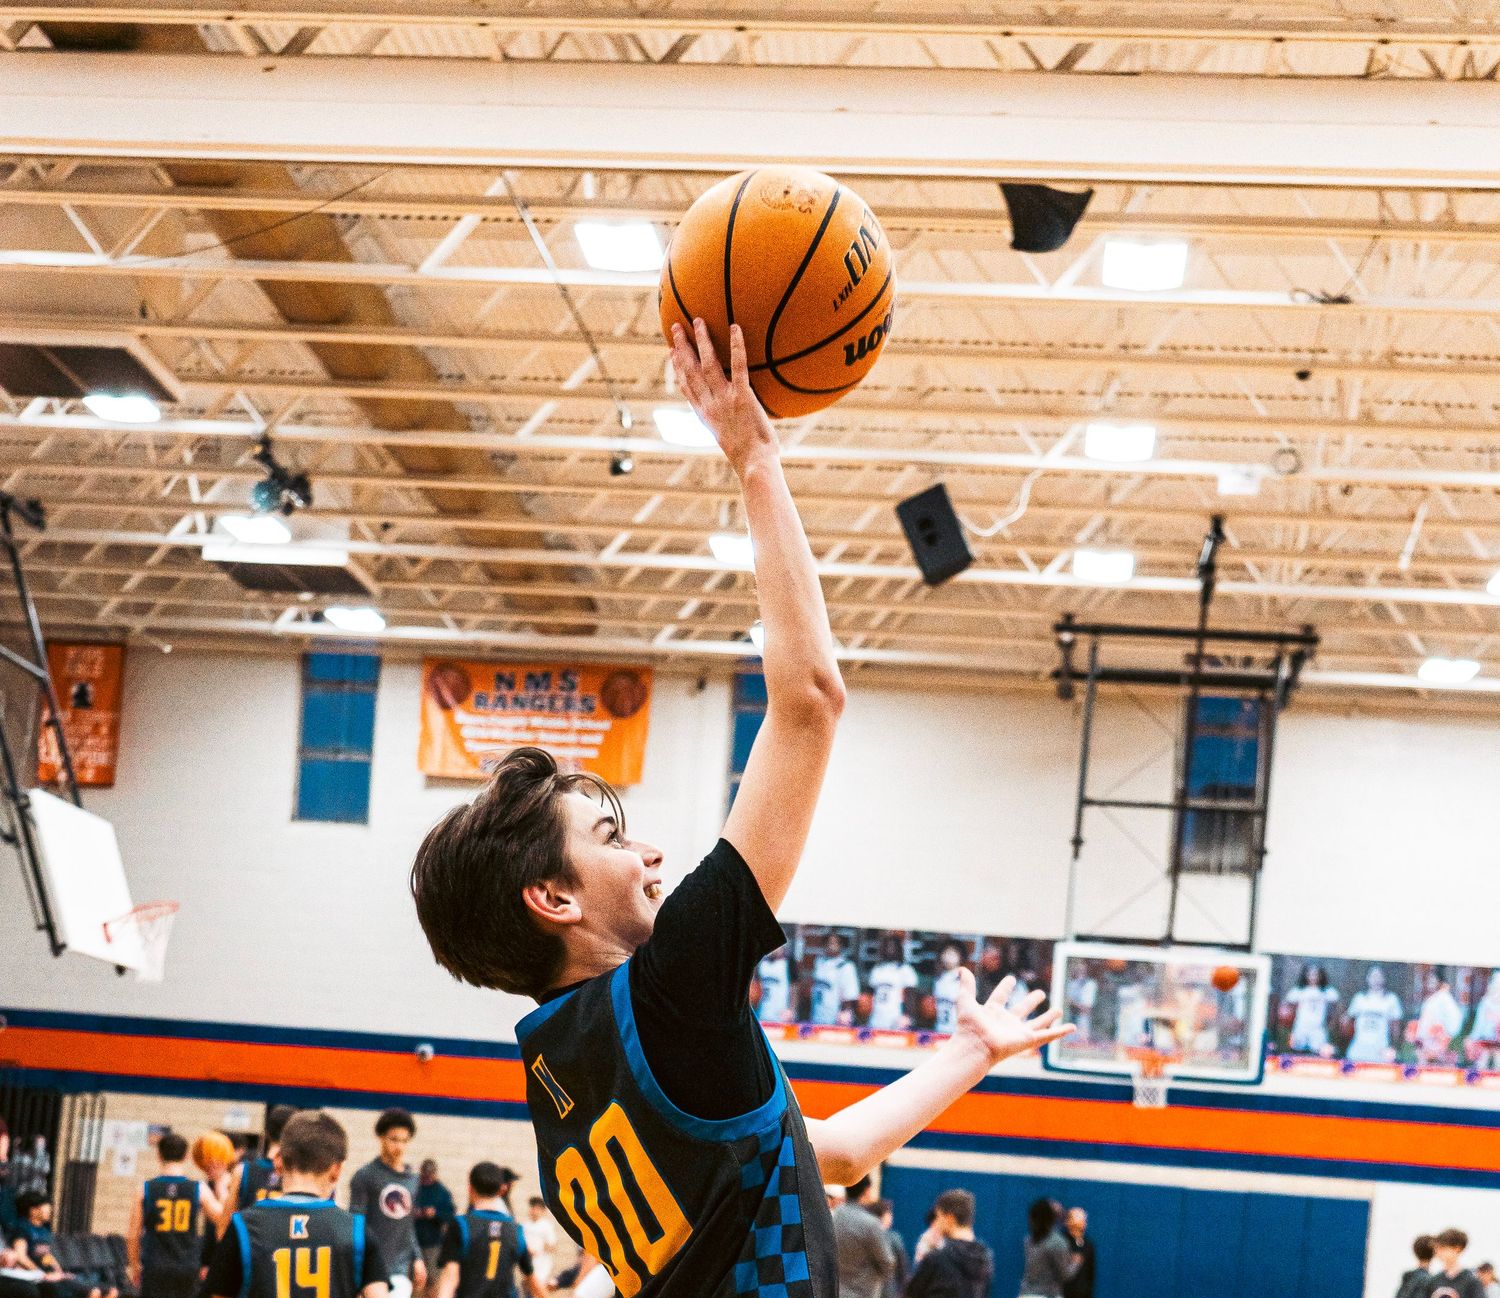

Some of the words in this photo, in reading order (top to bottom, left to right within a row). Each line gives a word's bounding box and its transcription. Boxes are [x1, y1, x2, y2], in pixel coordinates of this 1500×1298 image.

[475, 691, 597, 713] RANGERS
[155, 1199, 191, 1232] 30
[485, 1240, 501, 1280] 1
